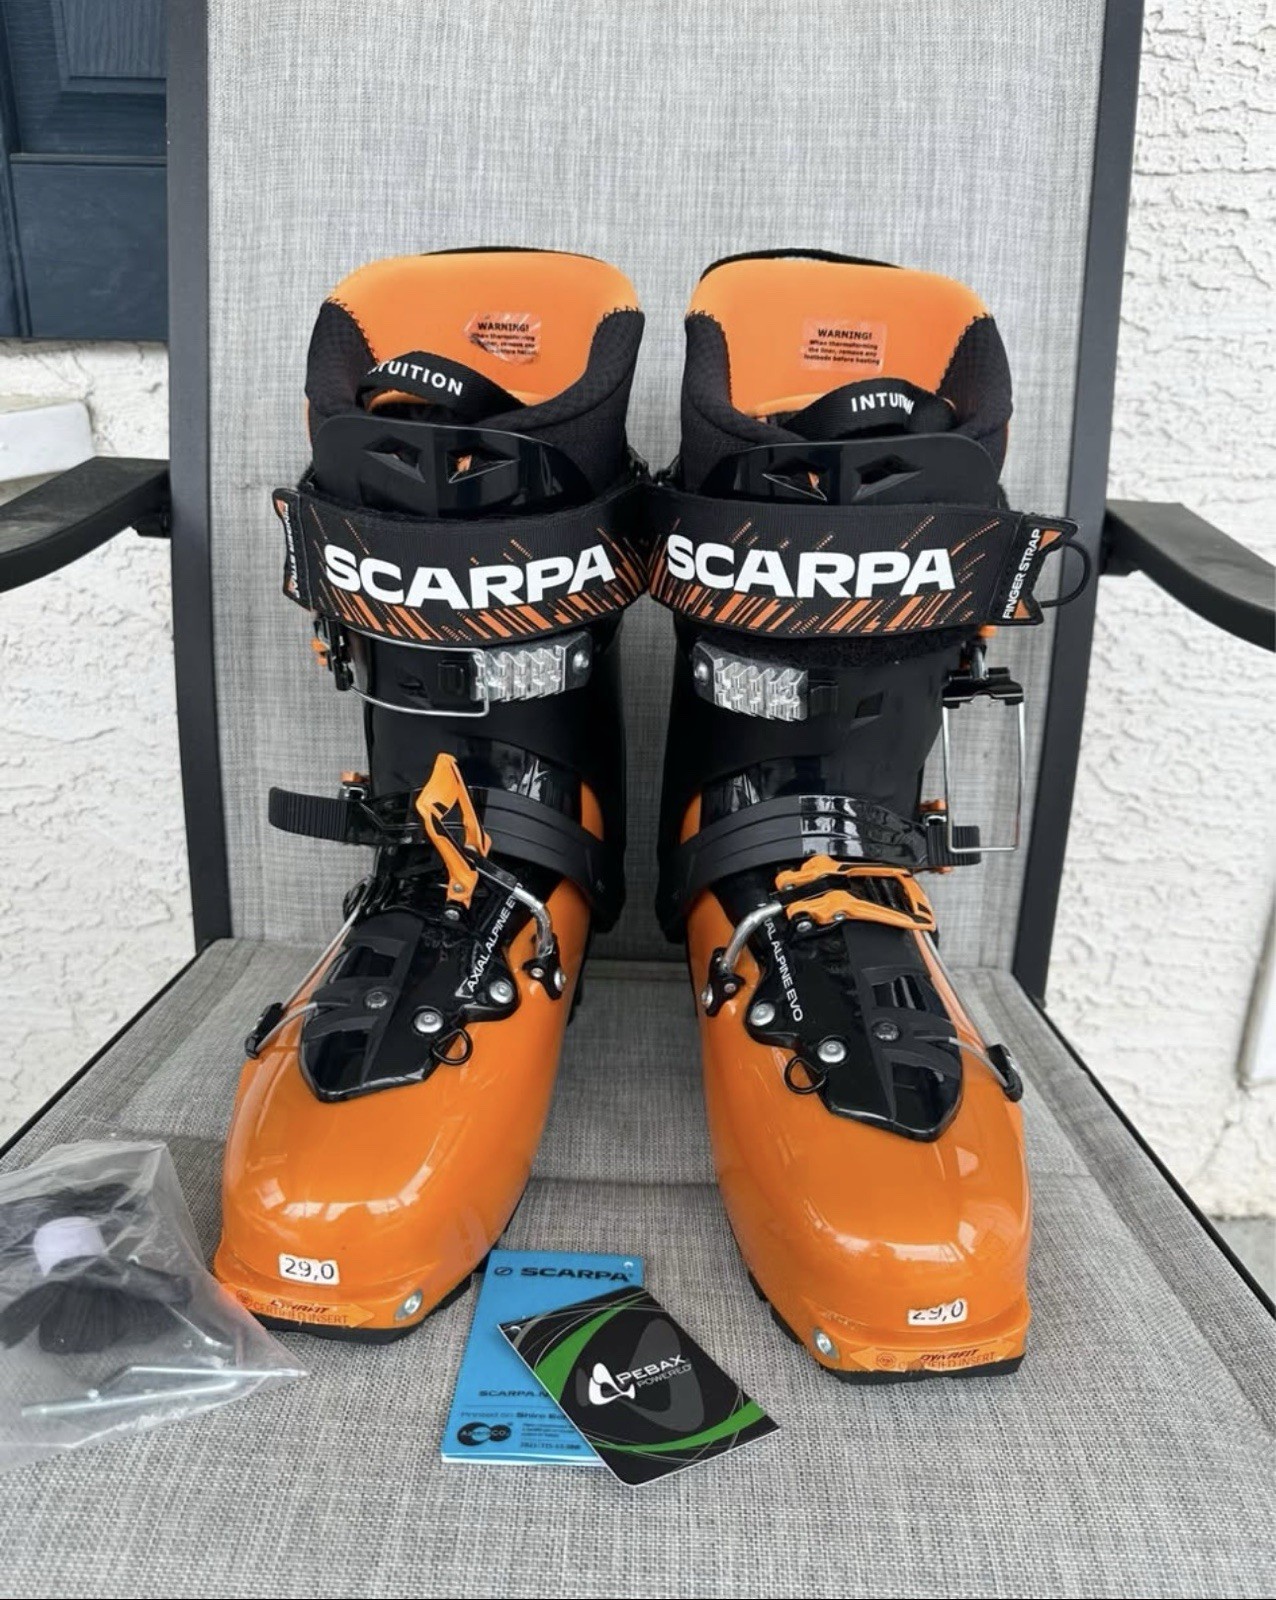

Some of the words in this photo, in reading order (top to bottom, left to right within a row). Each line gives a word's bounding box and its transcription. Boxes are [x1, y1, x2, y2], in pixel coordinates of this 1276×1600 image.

[477, 322, 529, 332] WARNING!
[817, 328, 873, 340] WARNING!
[367, 360, 464, 396] TUITION
[325, 544, 616, 609] SCARPA
[666, 535, 955, 598] SCARPA
[1002, 573, 1026, 619] FINGER
[1018, 528, 1041, 571] STRAP
[467, 954, 490, 993] AXIAL
[485, 907, 511, 954] ALPINE
[771, 940, 793, 989] ALPINE
[786, 988, 803, 1022] EVO
[285, 1257, 334, 1281] 29,0
[616, 1354, 686, 1385] PEBAX
[637, 1363, 692, 1388] POWERED
